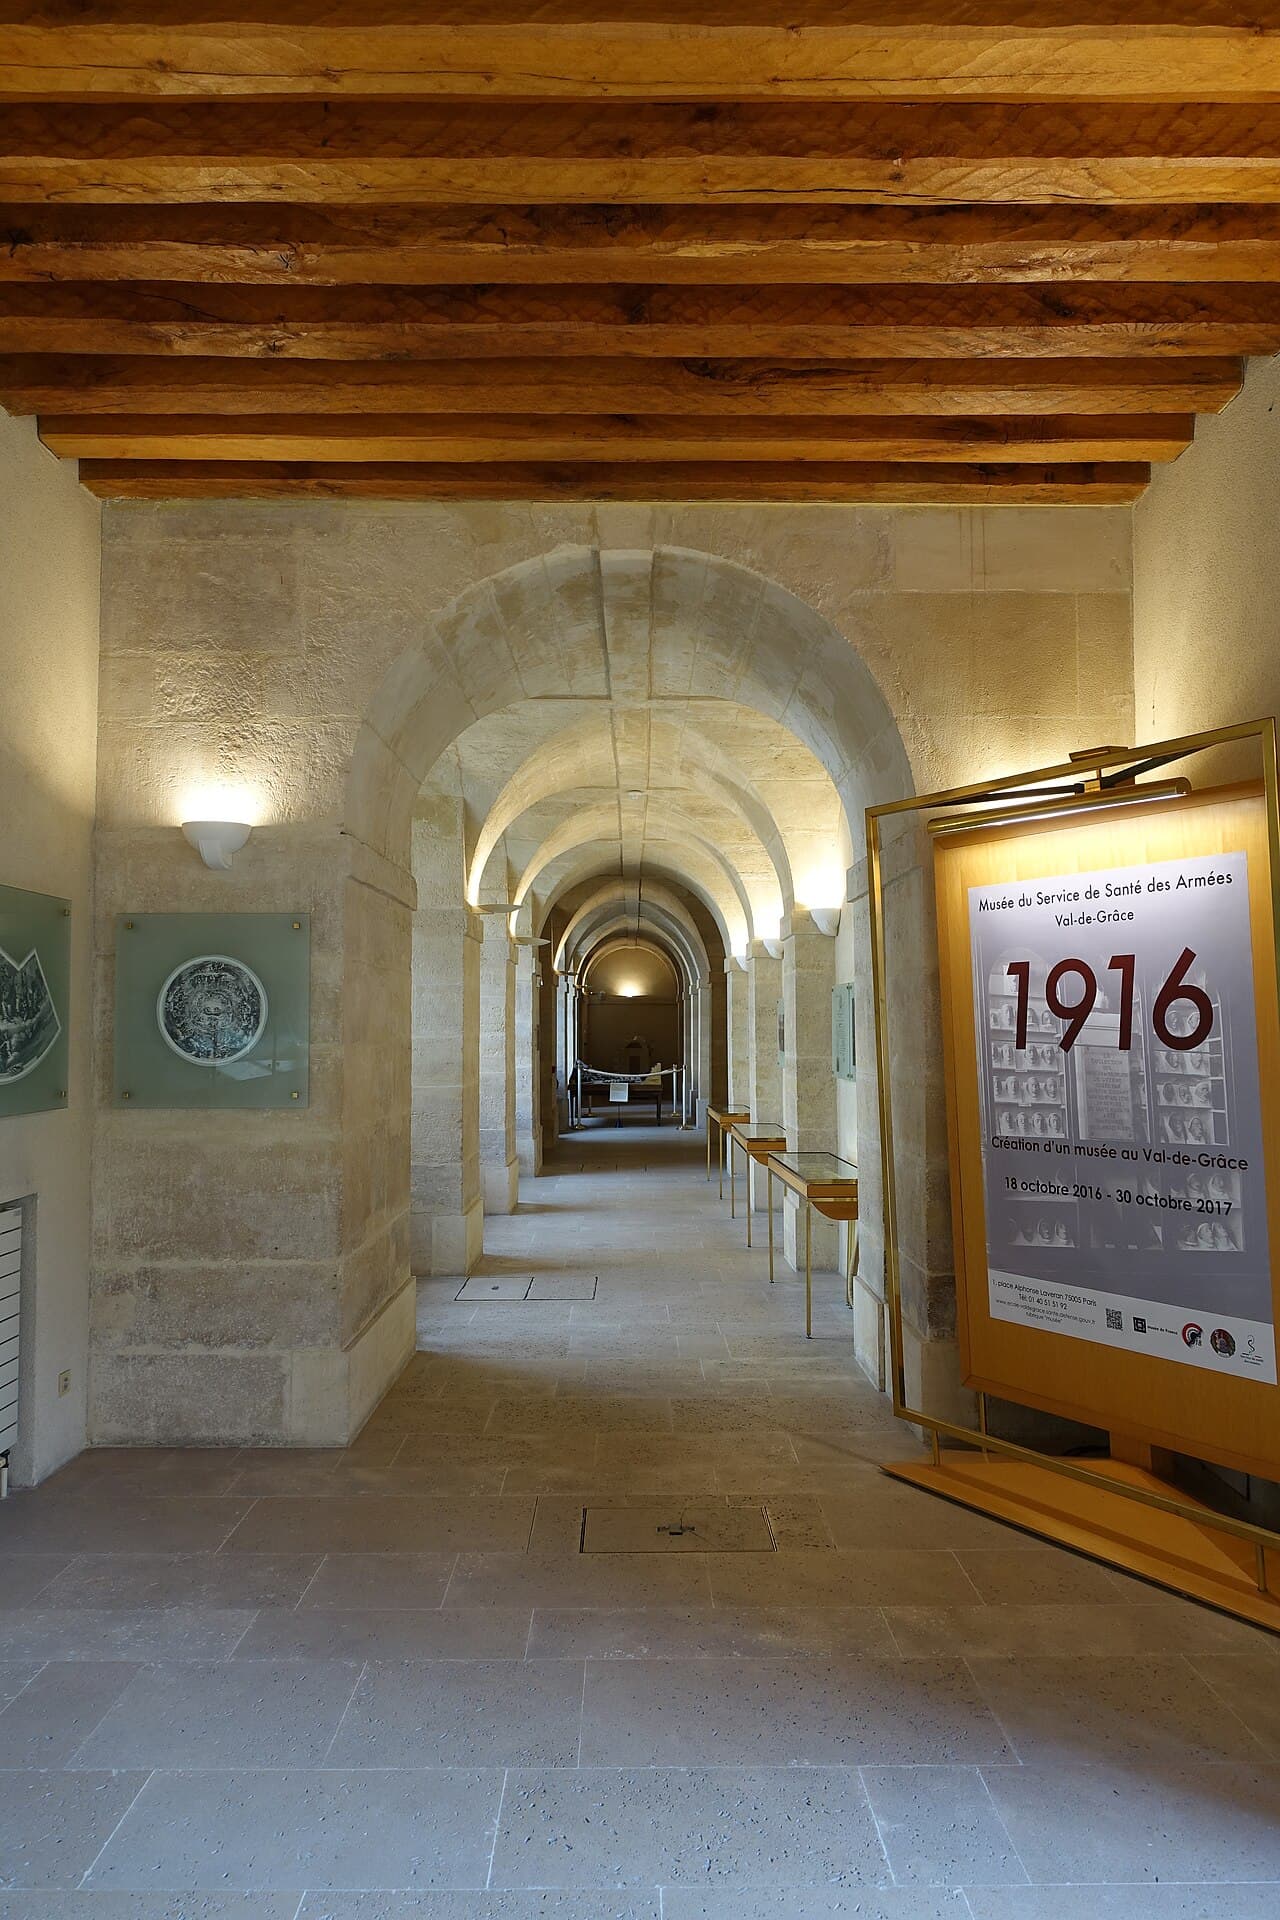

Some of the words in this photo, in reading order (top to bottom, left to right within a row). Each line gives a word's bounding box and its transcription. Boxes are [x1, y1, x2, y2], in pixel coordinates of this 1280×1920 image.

[979, 896, 1014, 912] Musée
[1018, 893, 1032, 908] du
[1036, 890, 1080, 905] Service
[1084, 885, 1100, 900] de
[1105, 880, 1142, 898] Santé
[1147, 877, 1171, 893] des
[1175, 870, 1233, 890] Armées
[1055, 909, 1134, 927] Val-de-Grâce
[1006, 946, 1214, 1053] 1916
[991, 1135, 1040, 1153] Création
[1043, 1139, 1070, 1155] d'un
[1074, 1143, 1117, 1159] musée
[1121, 1149, 1138, 1161] au
[1142, 1148, 1249, 1170] Val-de-Grâce
[1004, 1176, 1017, 1190] 18
[1020, 1179, 1069, 1197] octobre
[1072, 1184, 1102, 1200] 2016
[1116, 1190, 1132, 1204] 30
[1135, 1193, 1193, 1212] octobre
[1196, 1199, 1233, 1216] 2017
[997, 1281, 1013, 1290] place
[1014, 1283, 1039, 1295] Alphonse
[1040, 1289, 1064, 1300] Laveran
[1064, 1293, 1081, 1304] 75005
[1082, 1297, 1097, 1307] Paris
[1060, 1302, 1068, 1310] 92
